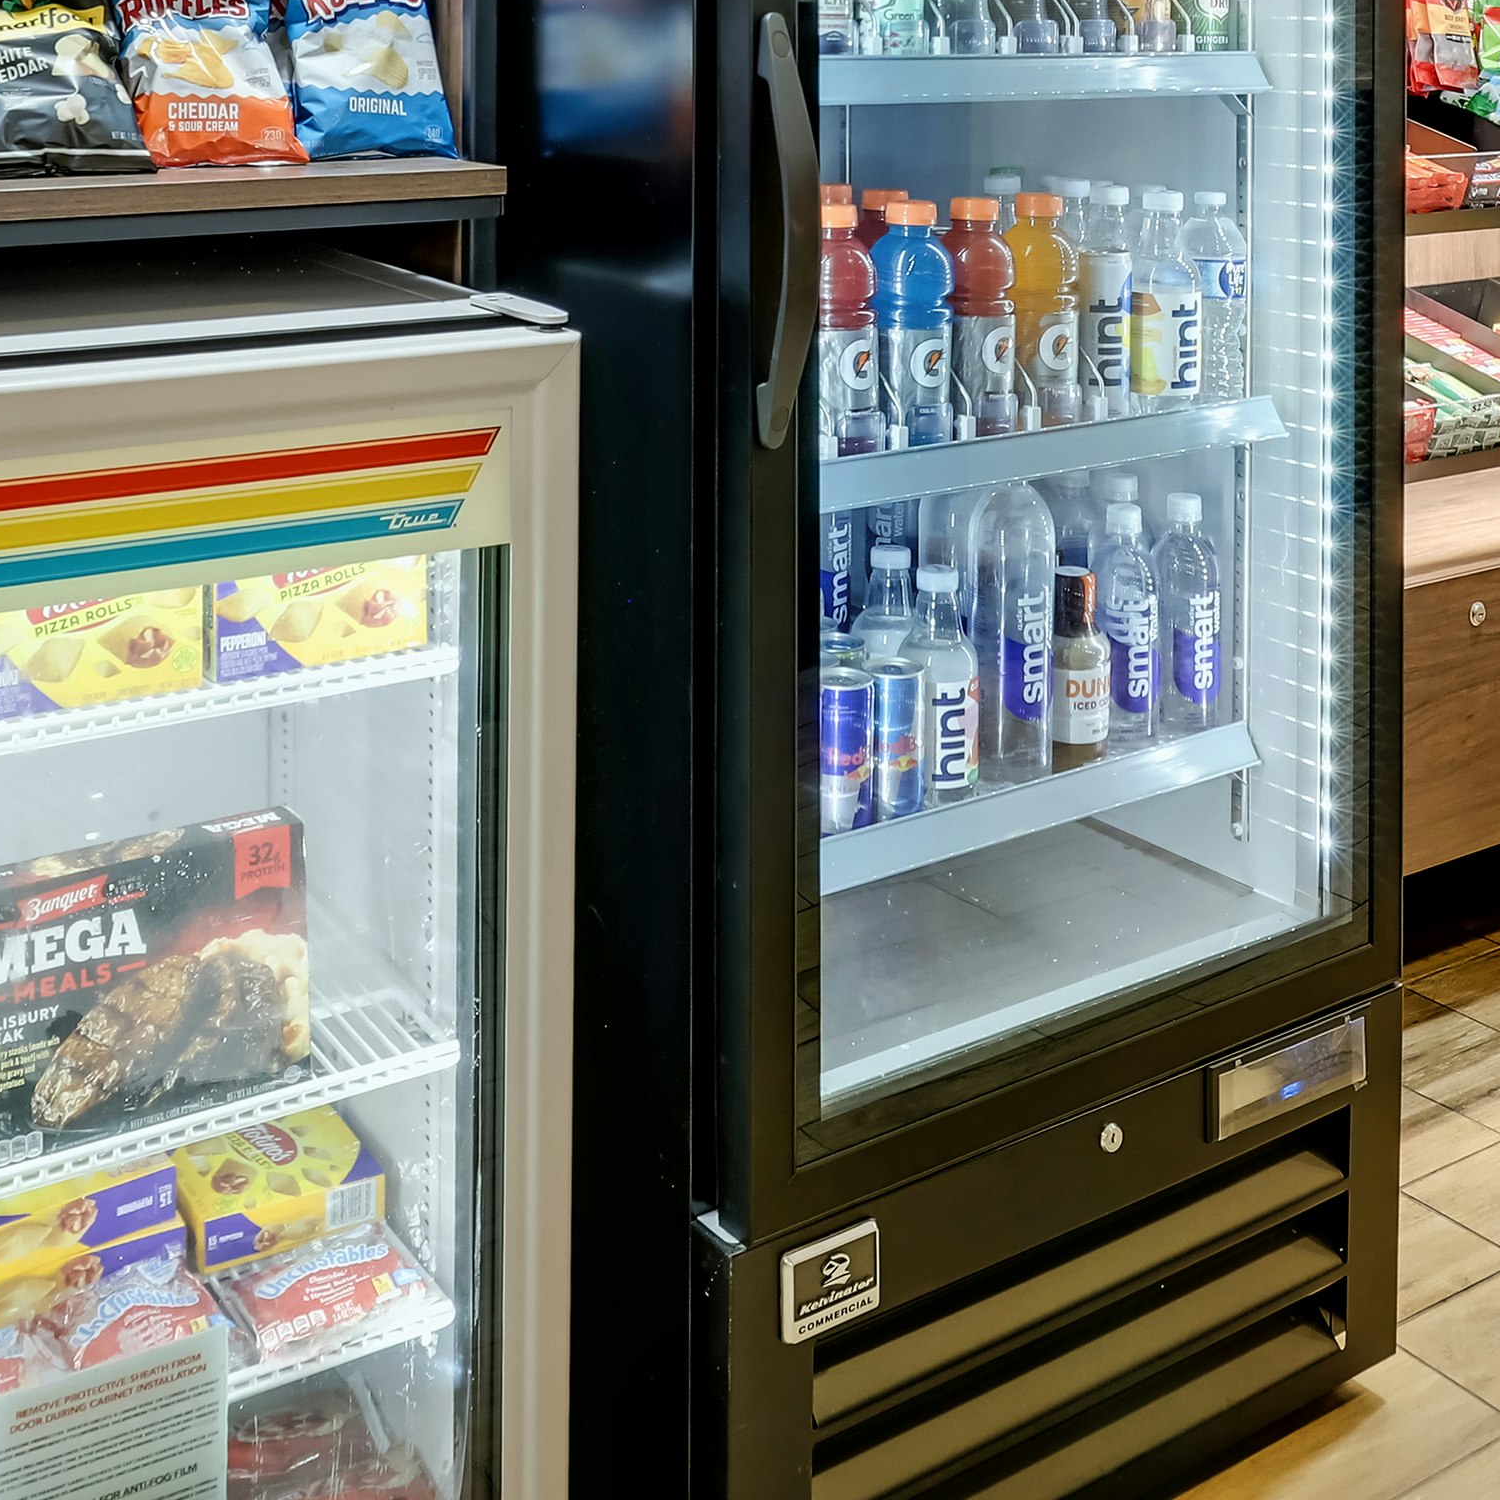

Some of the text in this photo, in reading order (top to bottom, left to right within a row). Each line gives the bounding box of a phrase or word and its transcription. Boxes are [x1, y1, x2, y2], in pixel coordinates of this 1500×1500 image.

[883, 9, 915, 21] Green
[168, 101, 240, 121] CHEDDAR
[168, 120, 239, 133] & SOUR CREAM
[349, 97, 407, 117] ORIGINAL
[264, 129, 282, 141] 230
[1228, 273, 1244, 285] Life
[1088, 296, 1123, 387] hint
[1170, 300, 1198, 389] hint
[379, 512, 448, 531] true
[280, 579, 320, 601] PIZZA
[325, 562, 366, 586] ROLLS
[829, 523, 848, 626] smart
[34, 615, 80, 638] PIZZA
[85, 598, 133, 622] ROLLS
[219, 630, 267, 653] PEPPERONI
[1017, 591, 1045, 705] smart
[1189, 591, 1215, 691] smart
[1073, 701, 1098, 711] ICED
[931, 687, 966, 783] hint
[117, 875, 142, 885] SINCE
[240, 862, 286, 882] PROTEIN
[25, 883, 99, 922] Banquet
[13, 963, 113, 1004] MEALS
[255, 1243, 389, 1300] Uncrustables
[798, 1296, 873, 1335] COMMERCIAL
[799, 1276, 874, 1317] Kelvinator
[9, 1363, 208, 1435] DOOR DURING CABINET INSTALLATION
[15, 1352, 202, 1420] REMOVE PROTECTIVE SHEATH FROM
[123, 1472, 173, 1497] ANTI-FOG
[173, 1463, 198, 1481] FILM
